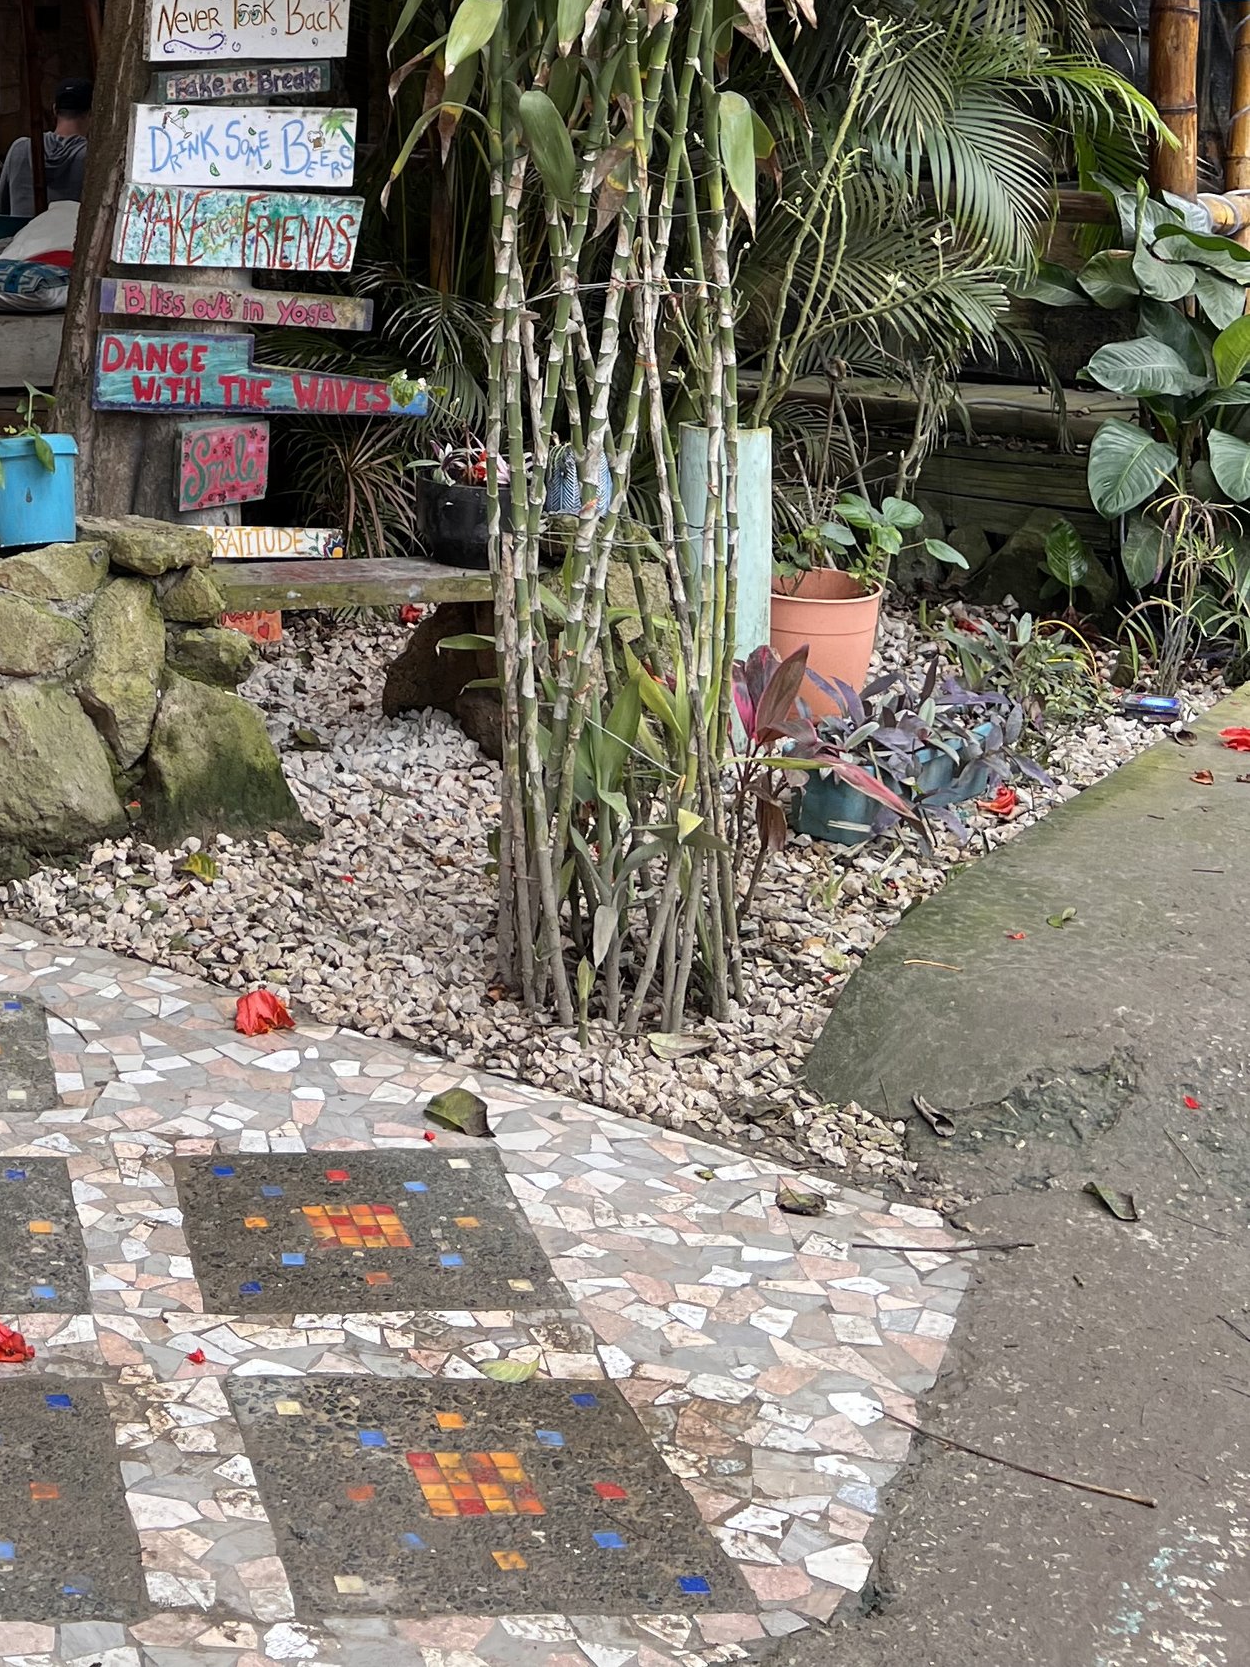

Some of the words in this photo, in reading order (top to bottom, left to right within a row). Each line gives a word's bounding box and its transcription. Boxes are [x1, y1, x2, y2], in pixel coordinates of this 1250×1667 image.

[171, 73, 225, 99] Take
[232, 75, 250, 94] a
[257, 68, 319, 95] Break
[148, 123, 220, 174] DRINK
[225, 120, 270, 167] SOME
[280, 119, 354, 179] BEERS
[119, 189, 213, 266] MAKE
[122, 283, 185, 318] Bliss
[193, 292, 233, 320] out
[243, 297, 264, 321] in
[101, 336, 208, 375] DANCE
[217, 374, 272, 408] THE
[290, 374, 391, 413] WAVES
[201, 525, 303, 558] RATITUDE
